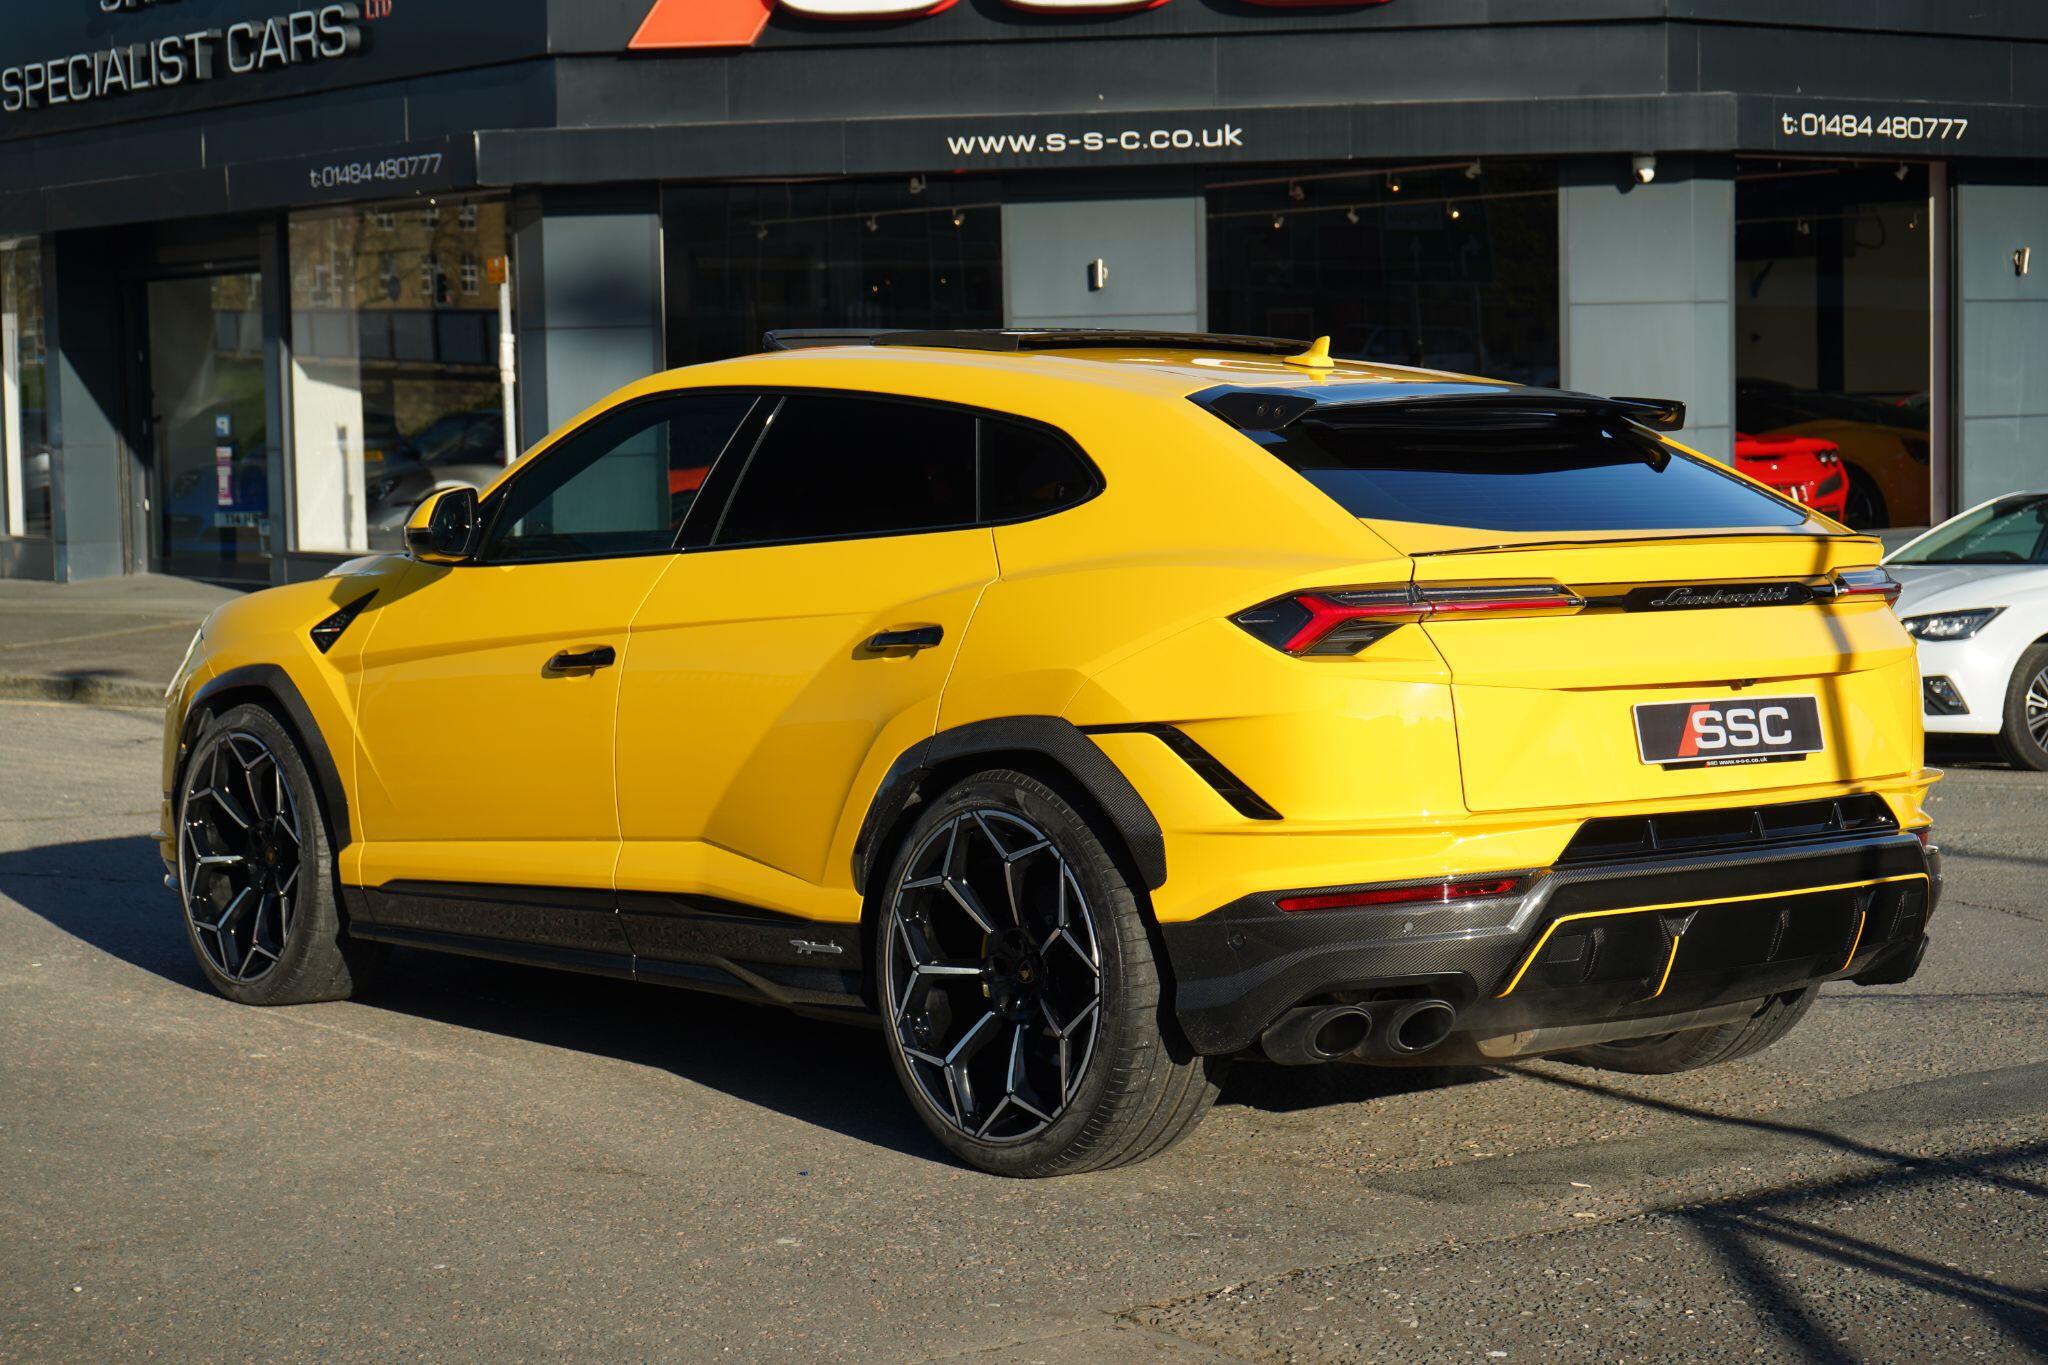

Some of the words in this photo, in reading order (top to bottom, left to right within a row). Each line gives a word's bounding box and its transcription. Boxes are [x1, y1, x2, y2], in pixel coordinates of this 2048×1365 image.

[1, 31, 208, 111] SPECIALIST
[227, 4, 348, 73] CARS
[947, 124, 1243, 155] www.s-s-c.co.uk
[1876, 116, 1968, 140] 480777
[374, 153, 442, 180] 480777
[1692, 706, 1792, 749] SSC
